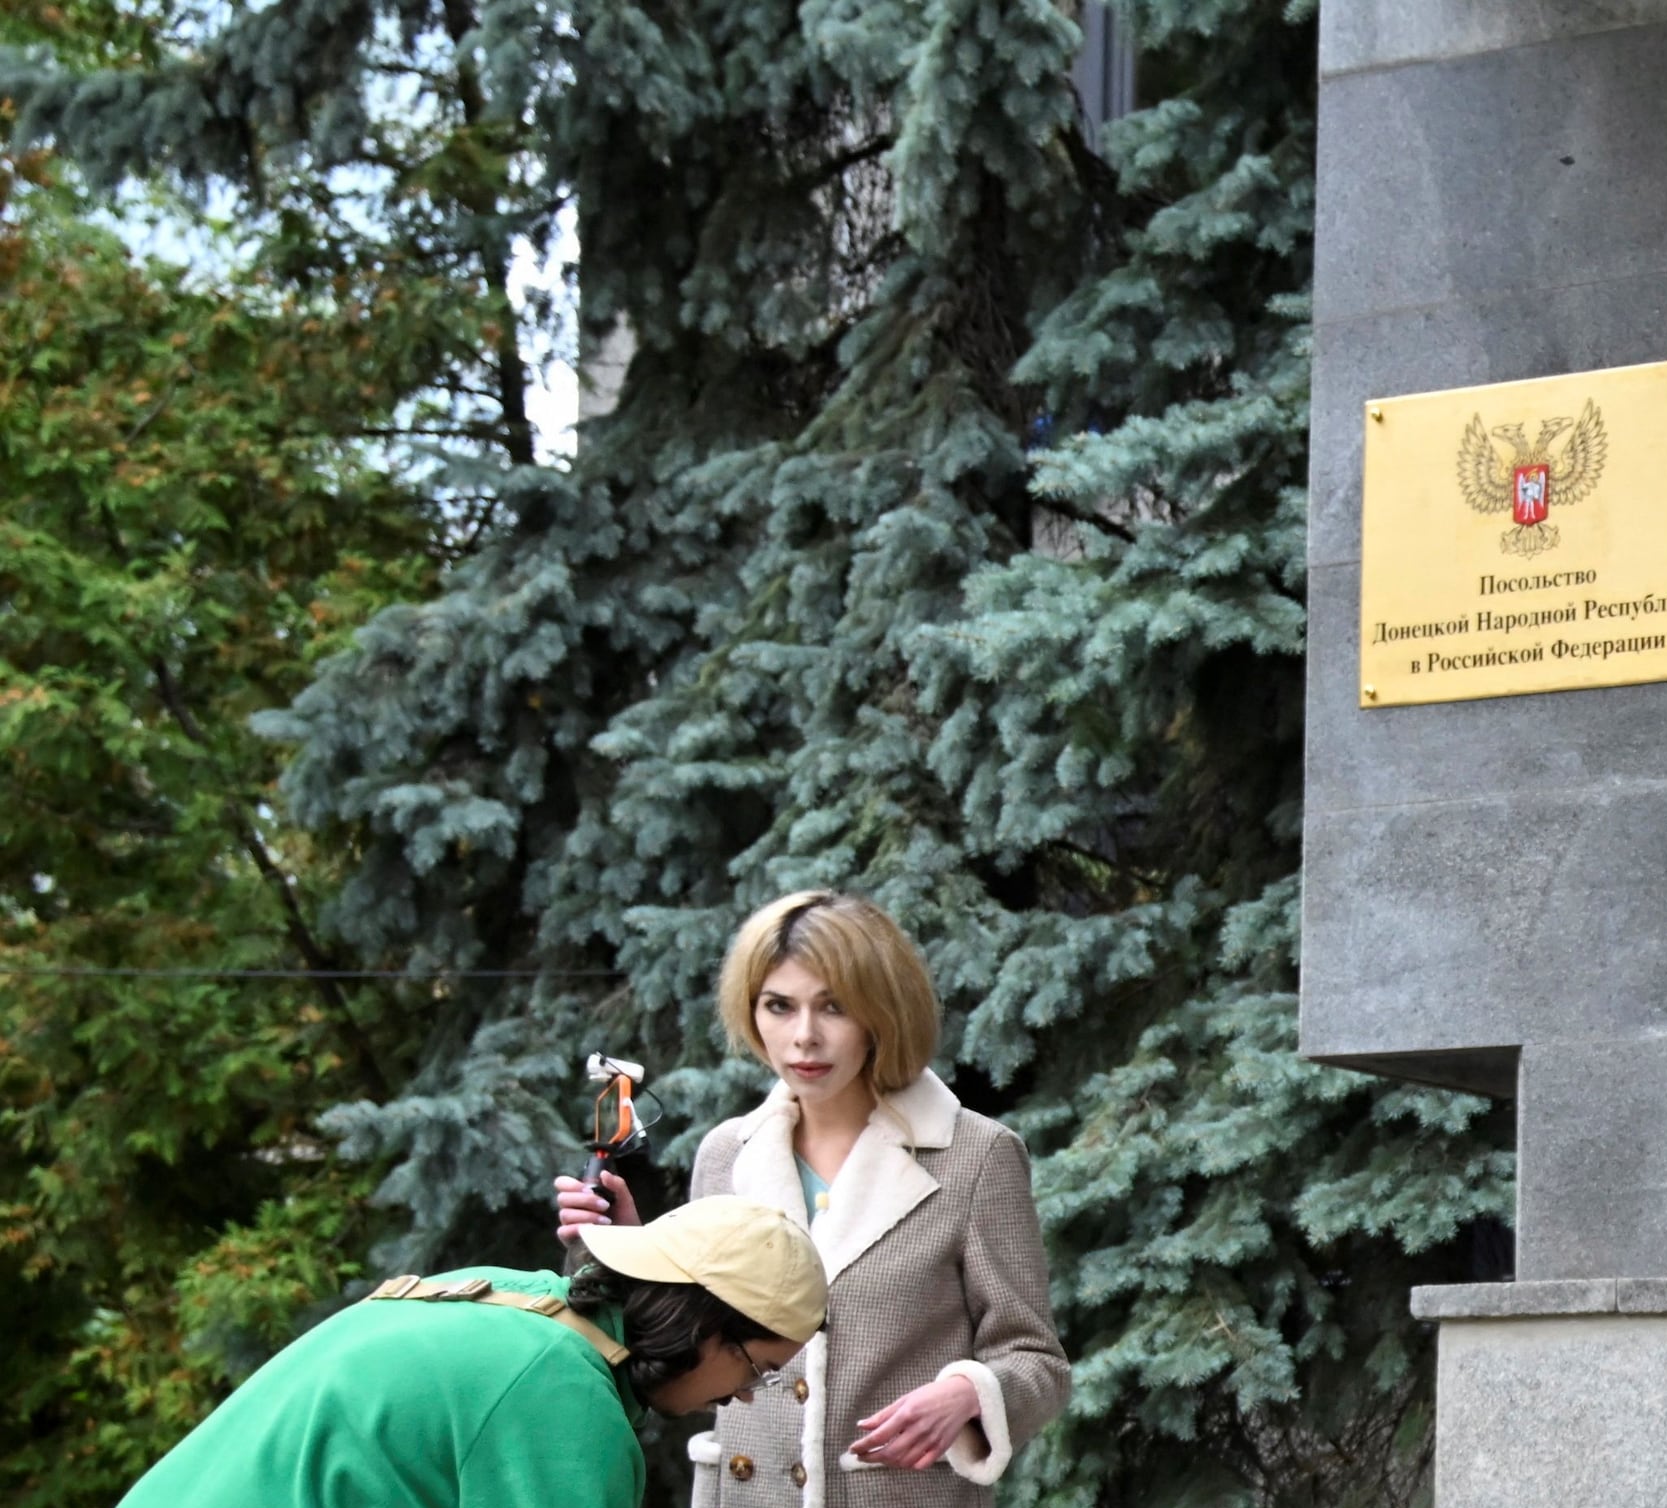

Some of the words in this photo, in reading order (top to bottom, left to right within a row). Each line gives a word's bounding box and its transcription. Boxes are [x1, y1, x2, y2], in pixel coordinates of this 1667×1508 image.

[1479, 568, 1597, 596] Посольство
[1372, 614, 1469, 645] Донецкой
[1476, 602, 1577, 634] Народной
[1410, 659, 1420, 674] в
[1427, 642, 1544, 673] Российской
[1551, 633, 1666, 660] Федерации
